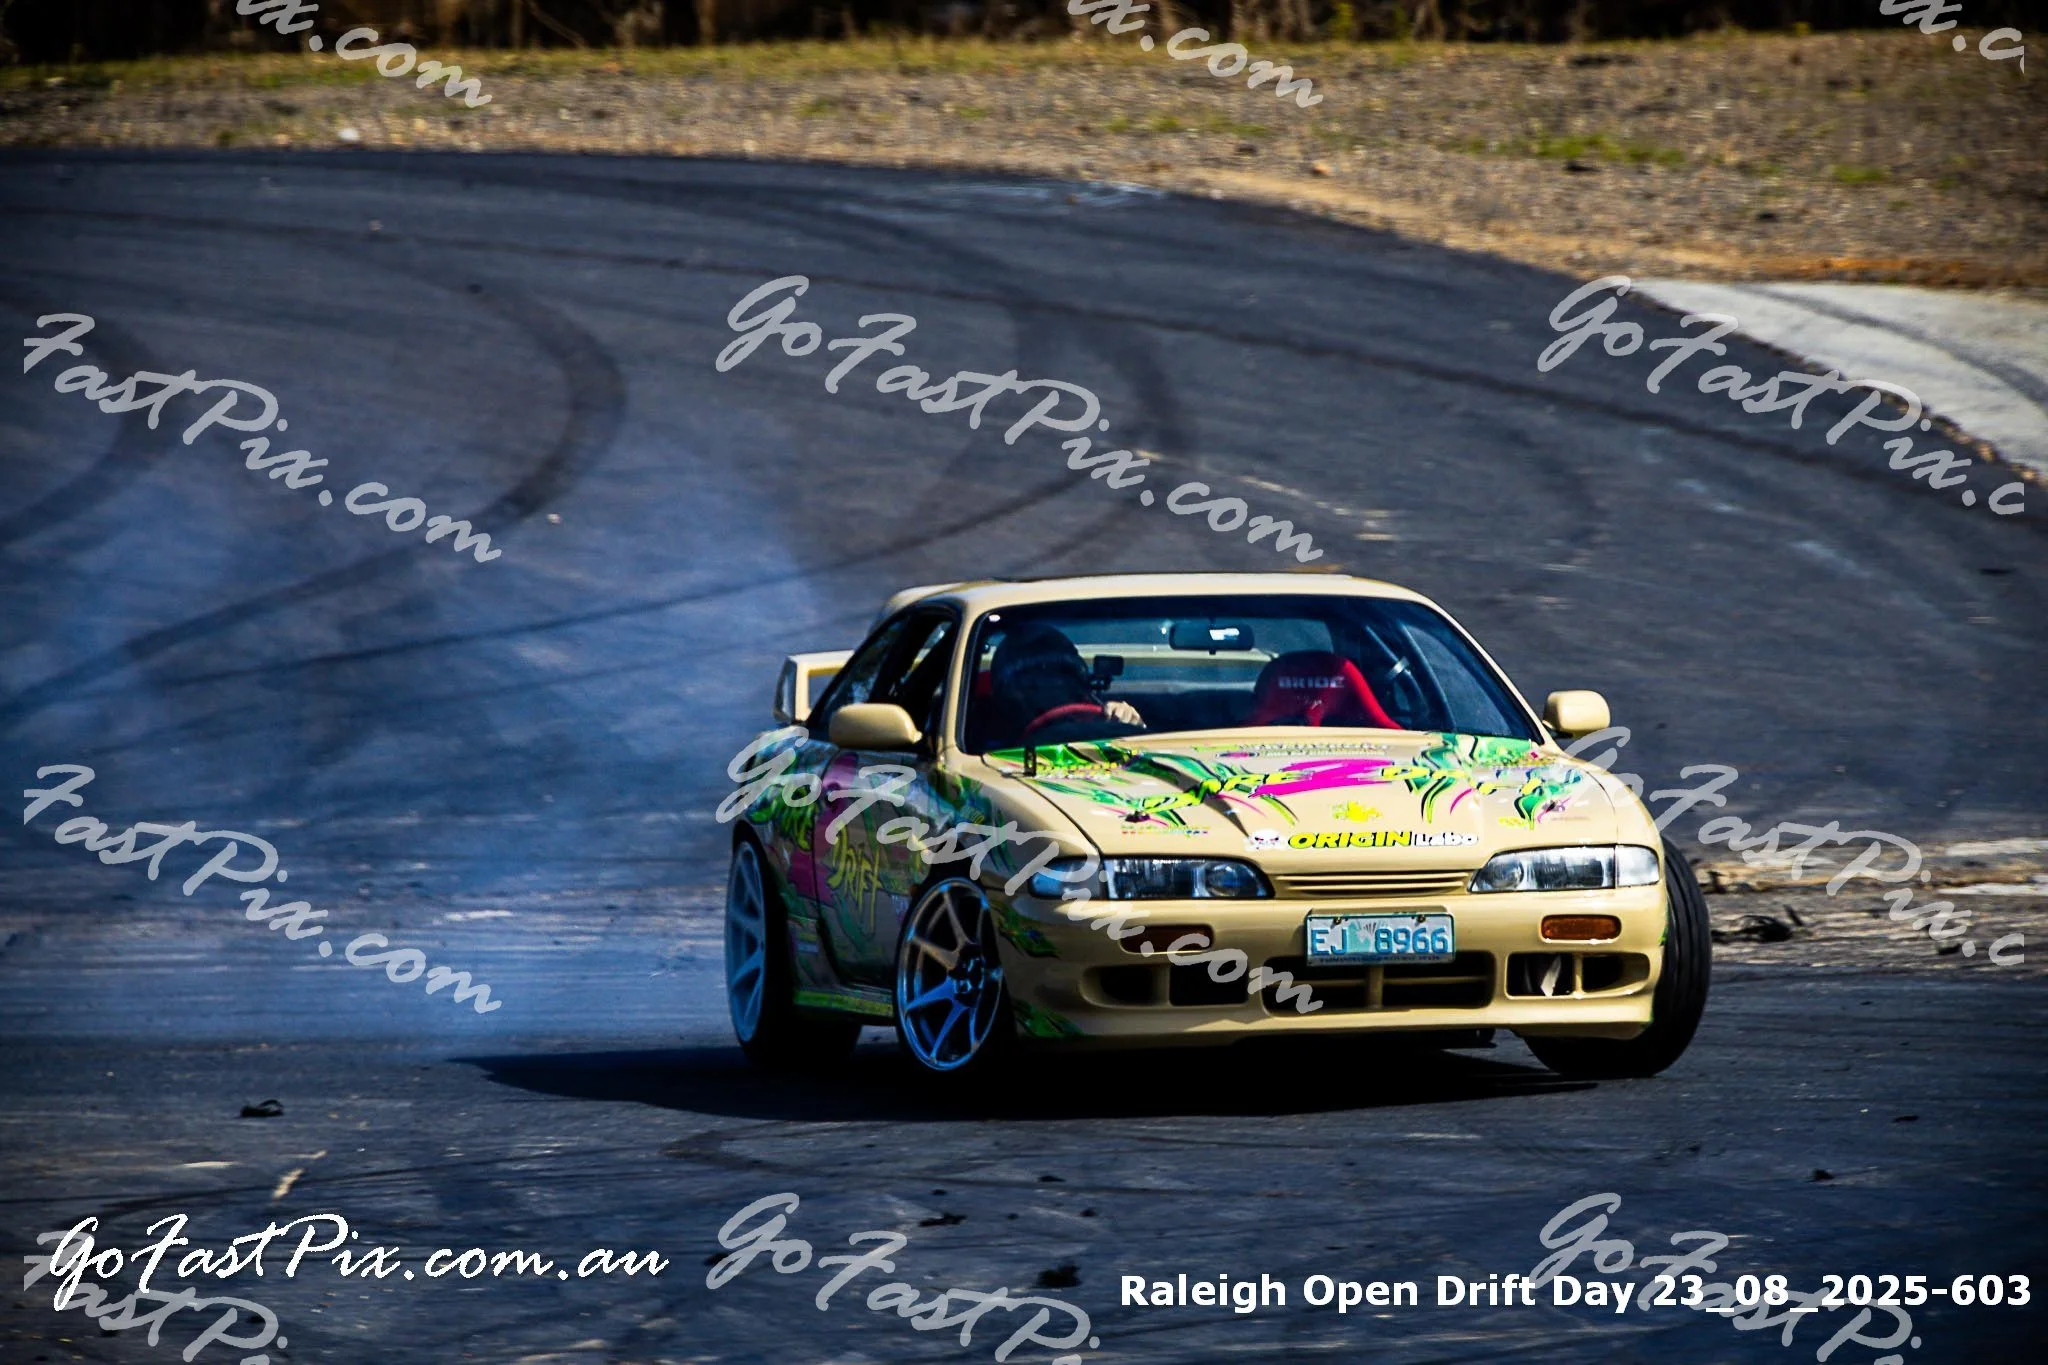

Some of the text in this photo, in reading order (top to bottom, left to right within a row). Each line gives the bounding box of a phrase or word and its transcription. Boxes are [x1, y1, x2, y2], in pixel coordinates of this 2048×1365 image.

[1277, 675, 1345, 688] BRIDE
[1288, 830, 1479, 849] ORIGIN Labo
[1310, 927, 1450, 955] EJ 8966
